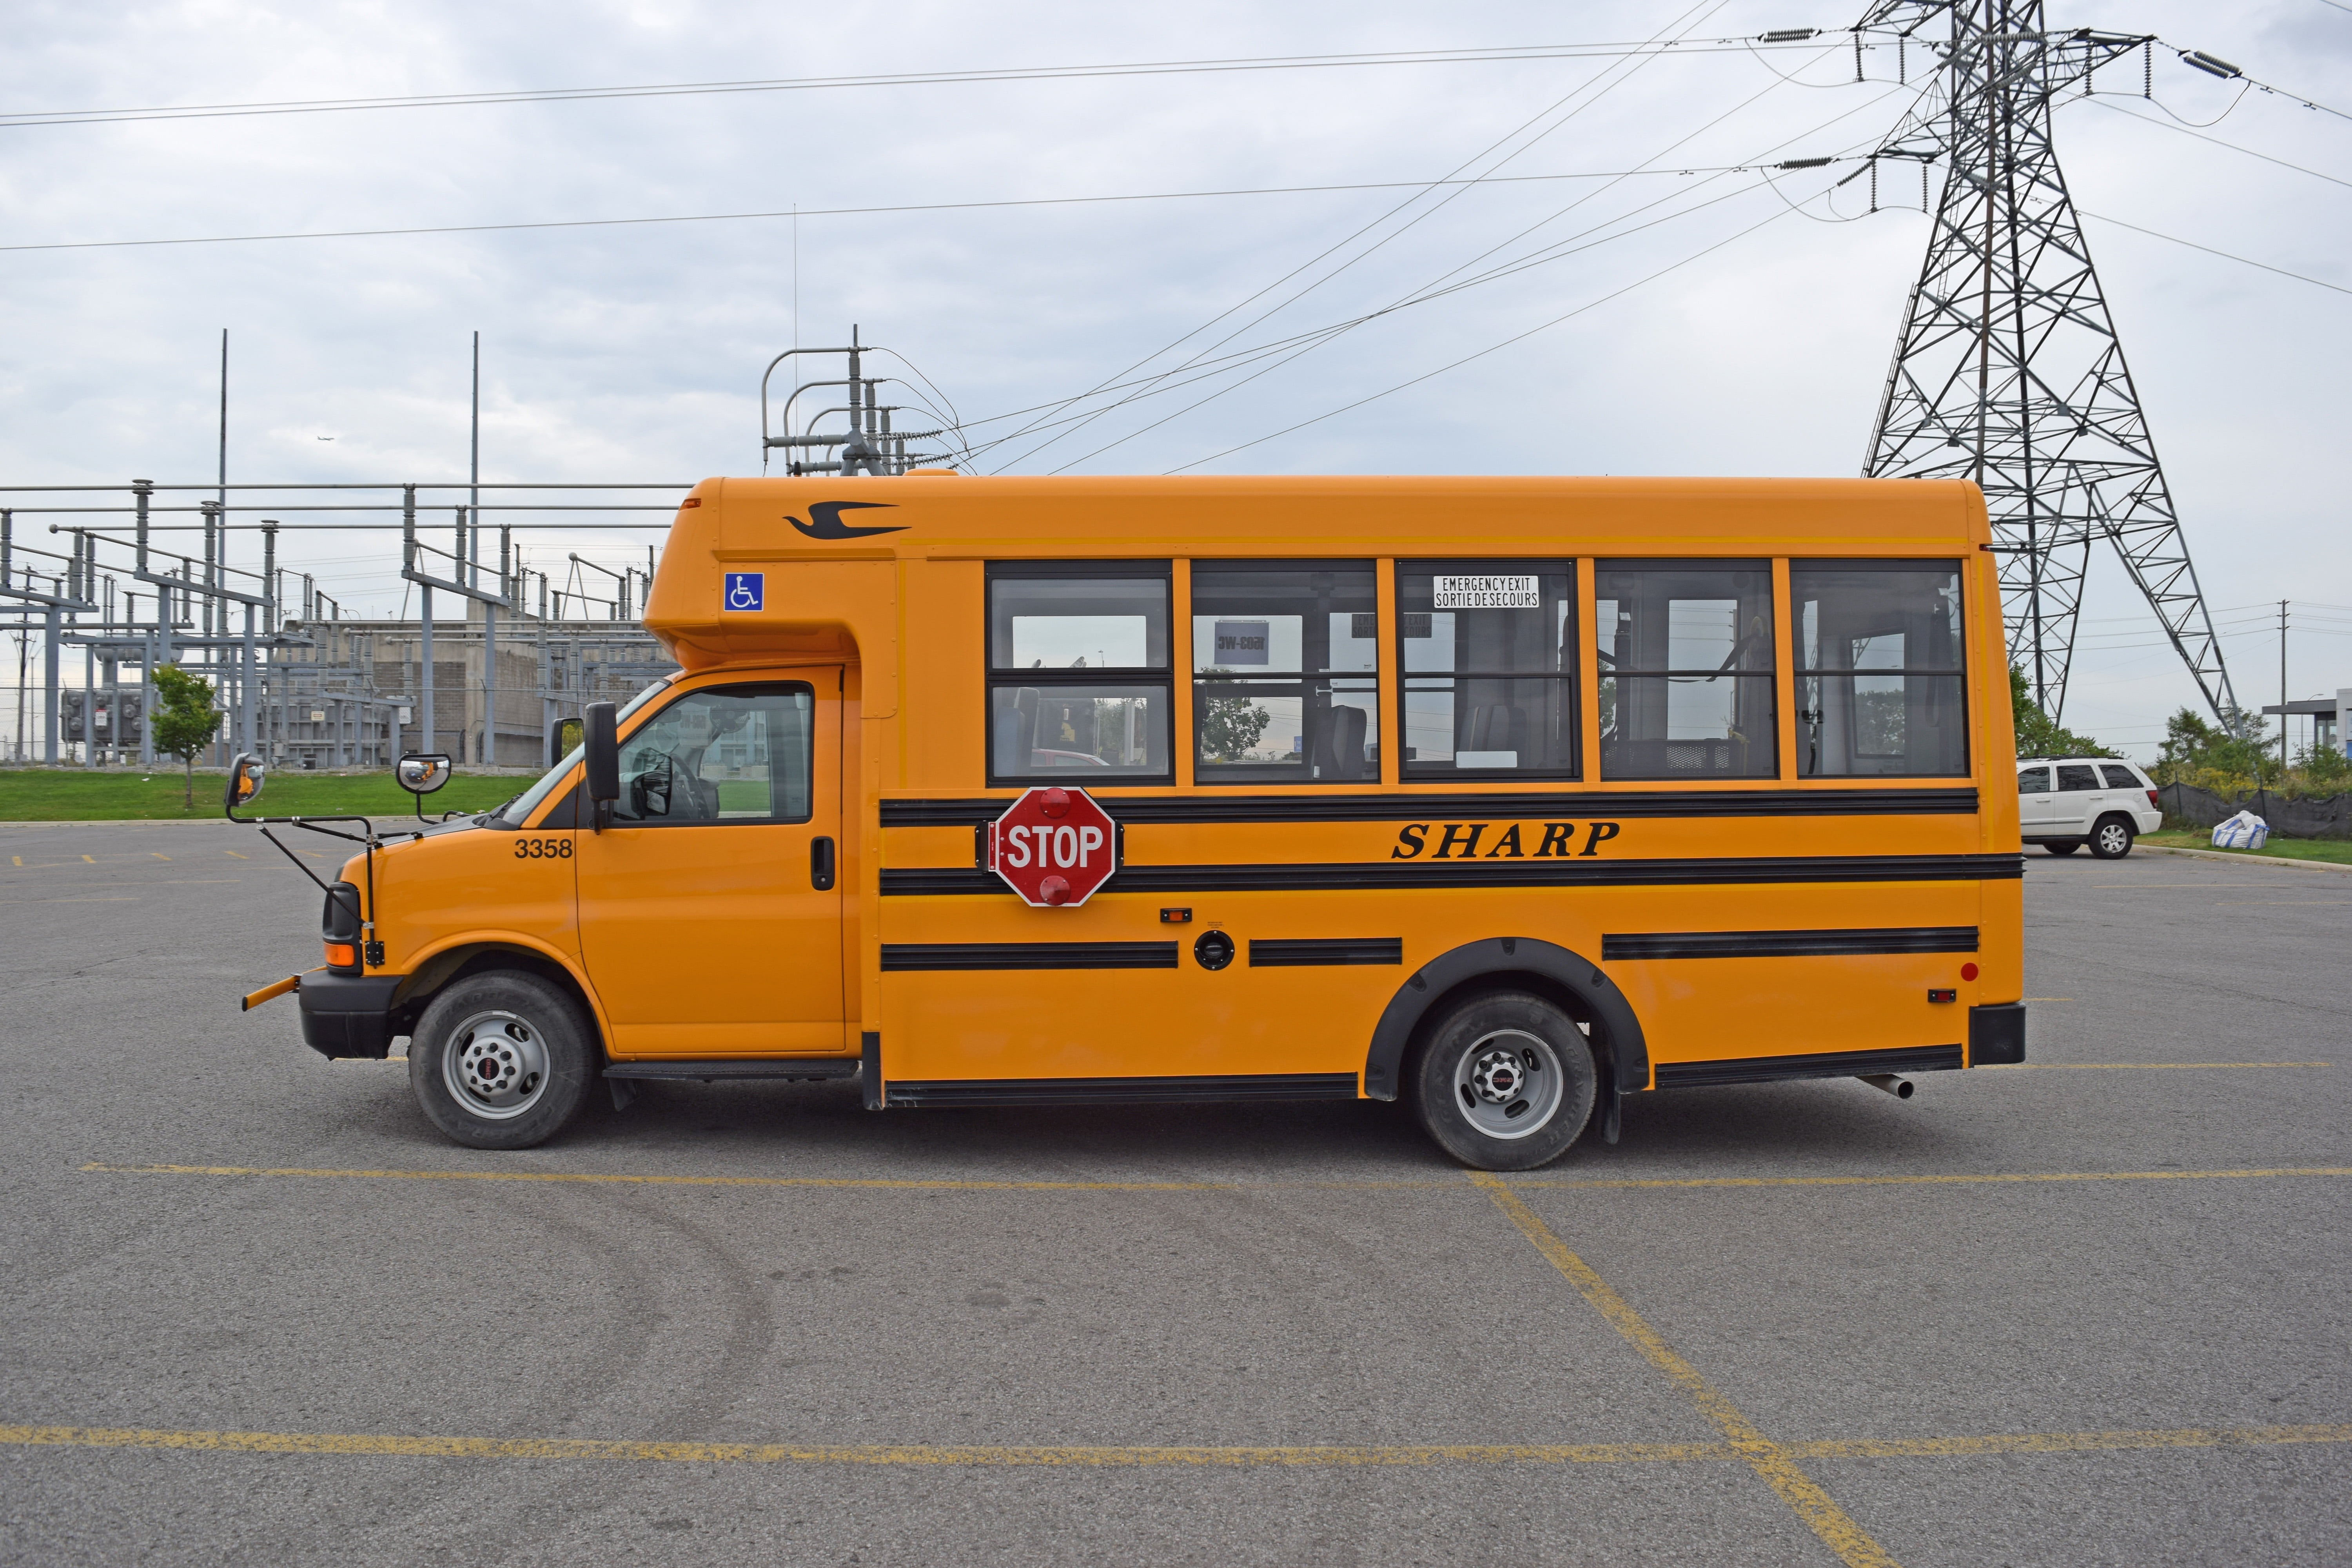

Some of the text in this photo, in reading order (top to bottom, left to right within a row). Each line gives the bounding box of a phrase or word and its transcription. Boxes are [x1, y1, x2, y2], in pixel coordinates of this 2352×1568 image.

[1443, 577, 1530, 591] EMERGENCY EXIT
[1436, 593, 1537, 606] SORTIE DE SECOURS
[514, 839, 572, 858] 3358
[1007, 825, 1103, 867] STOP
[1391, 822, 1620, 859] SHARP
